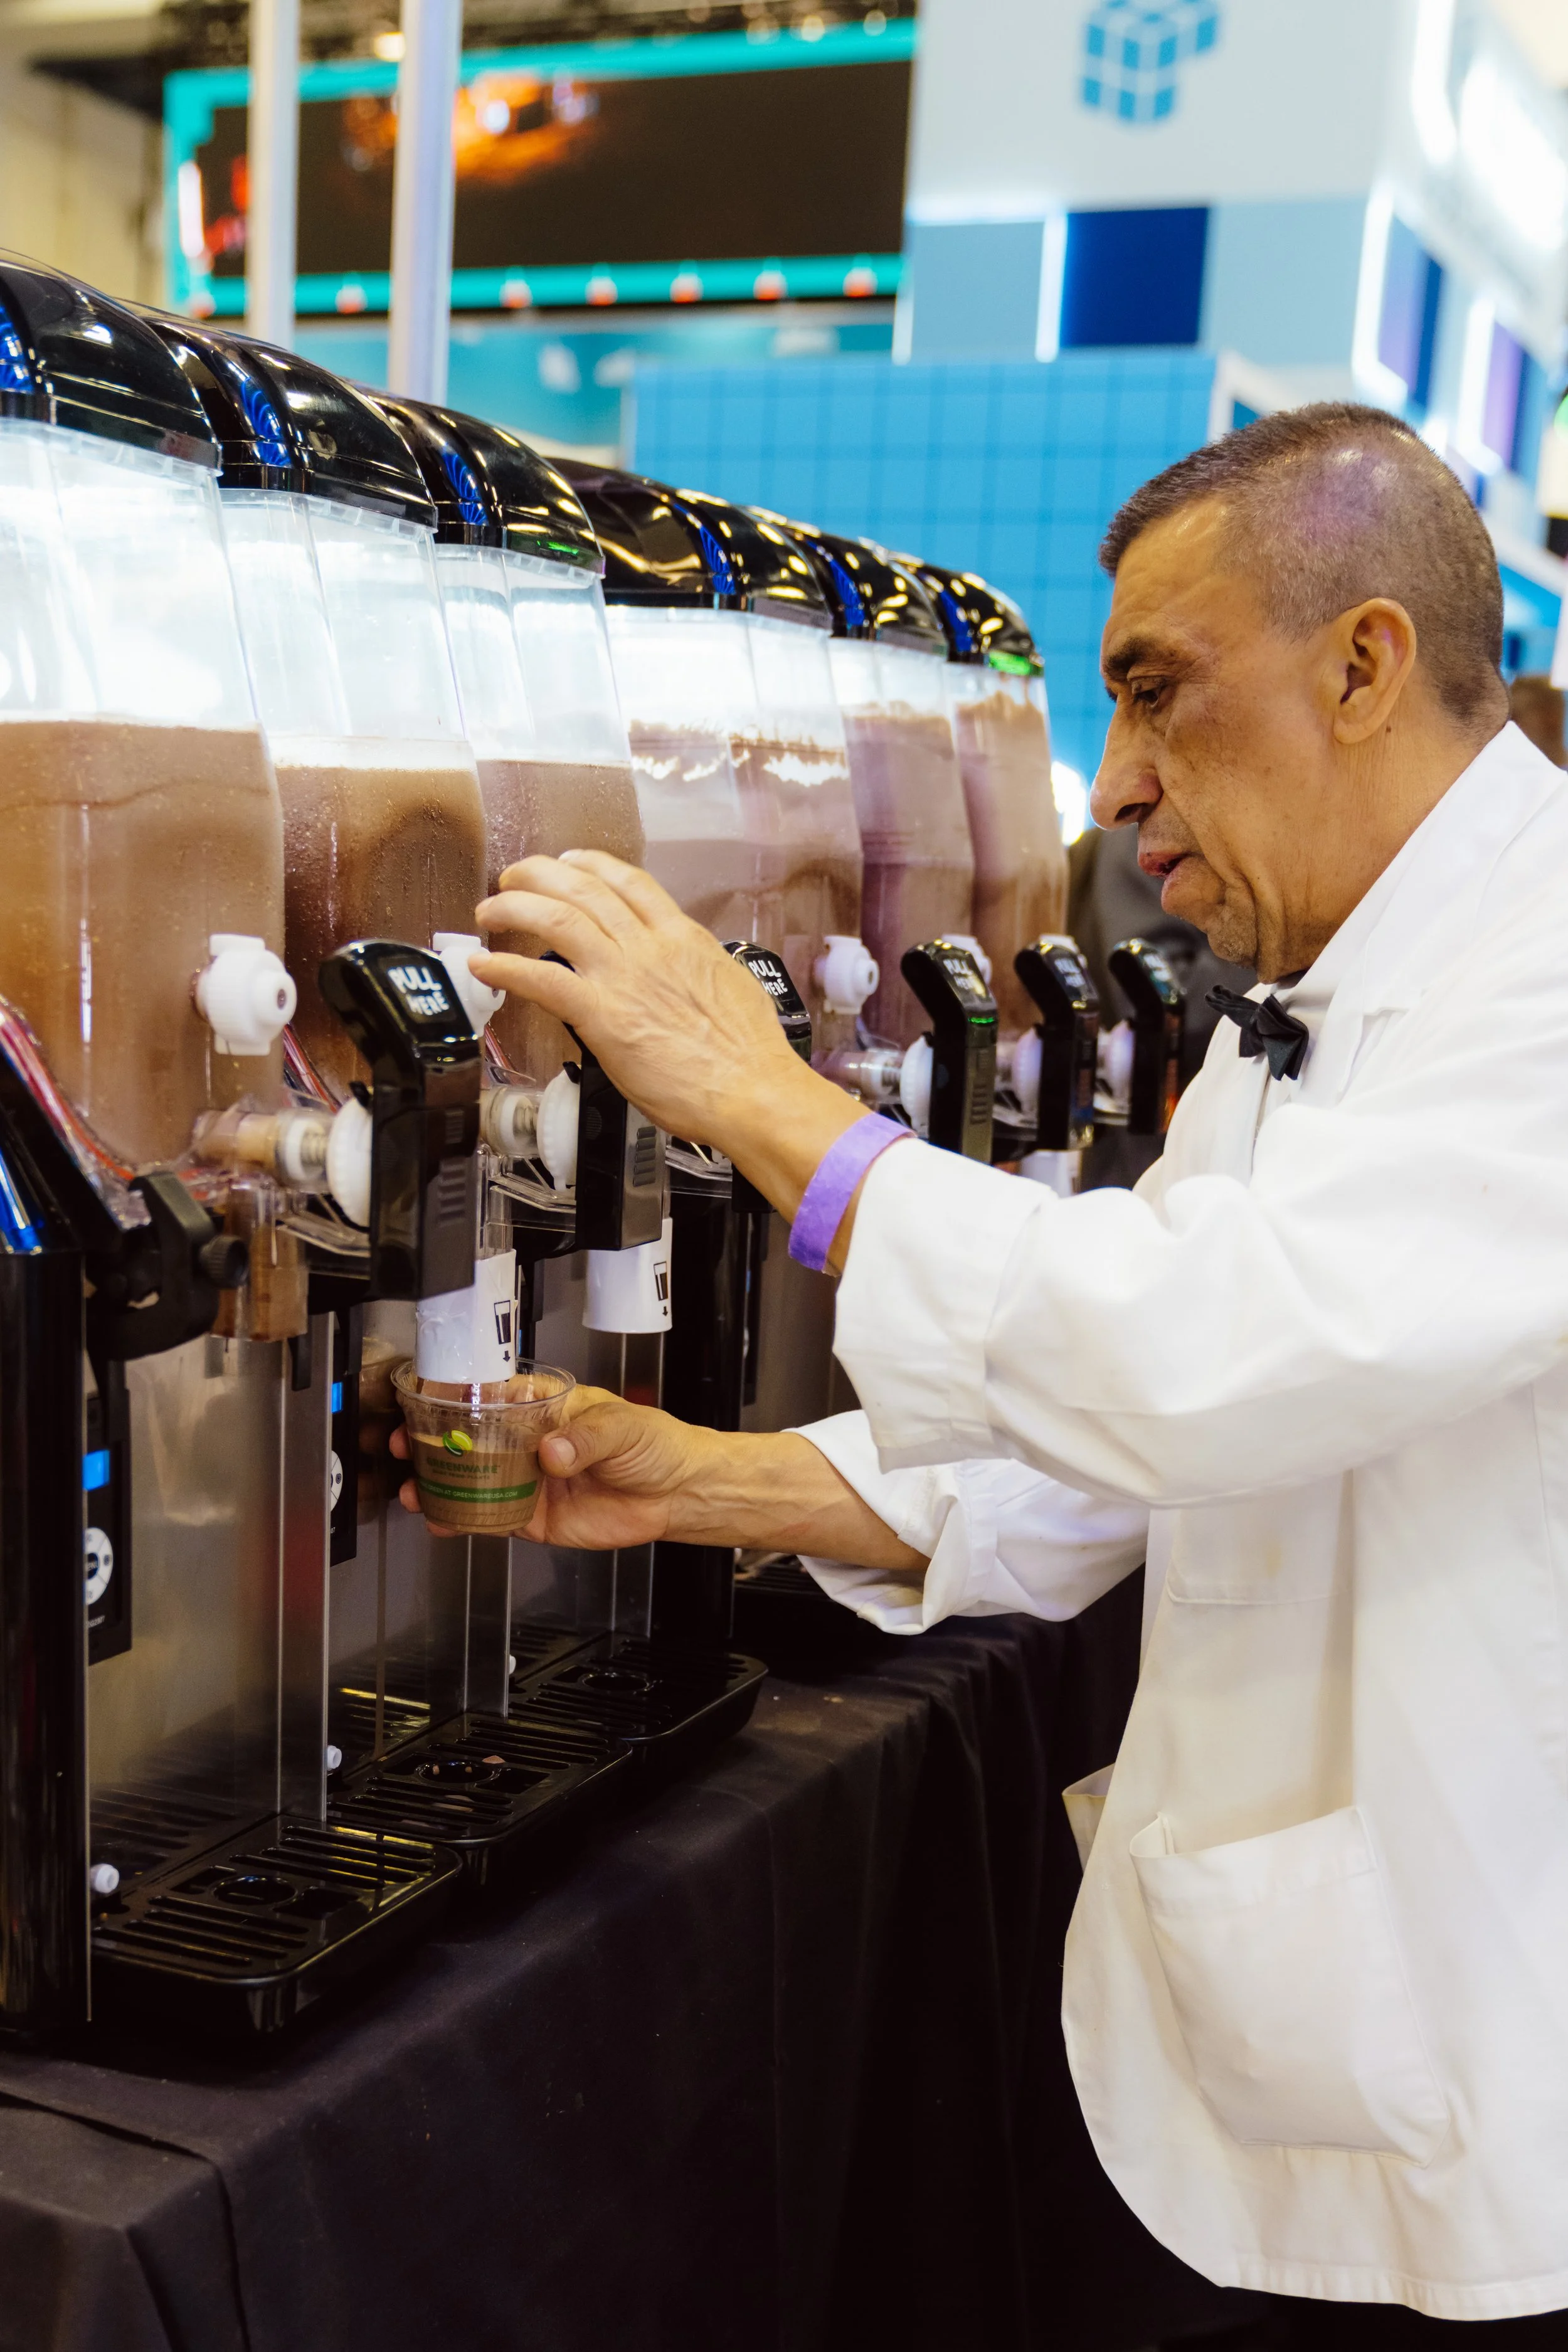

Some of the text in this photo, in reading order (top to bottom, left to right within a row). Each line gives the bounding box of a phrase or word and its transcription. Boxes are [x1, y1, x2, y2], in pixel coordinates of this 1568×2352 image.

[748, 960, 781, 978] PULL
[388, 967, 442, 993] PULL
[761, 978, 788, 996] HERE
[405, 991, 450, 1015] HERE
[452, 1490, 518, 1499] GREENWAREUSA.COM
